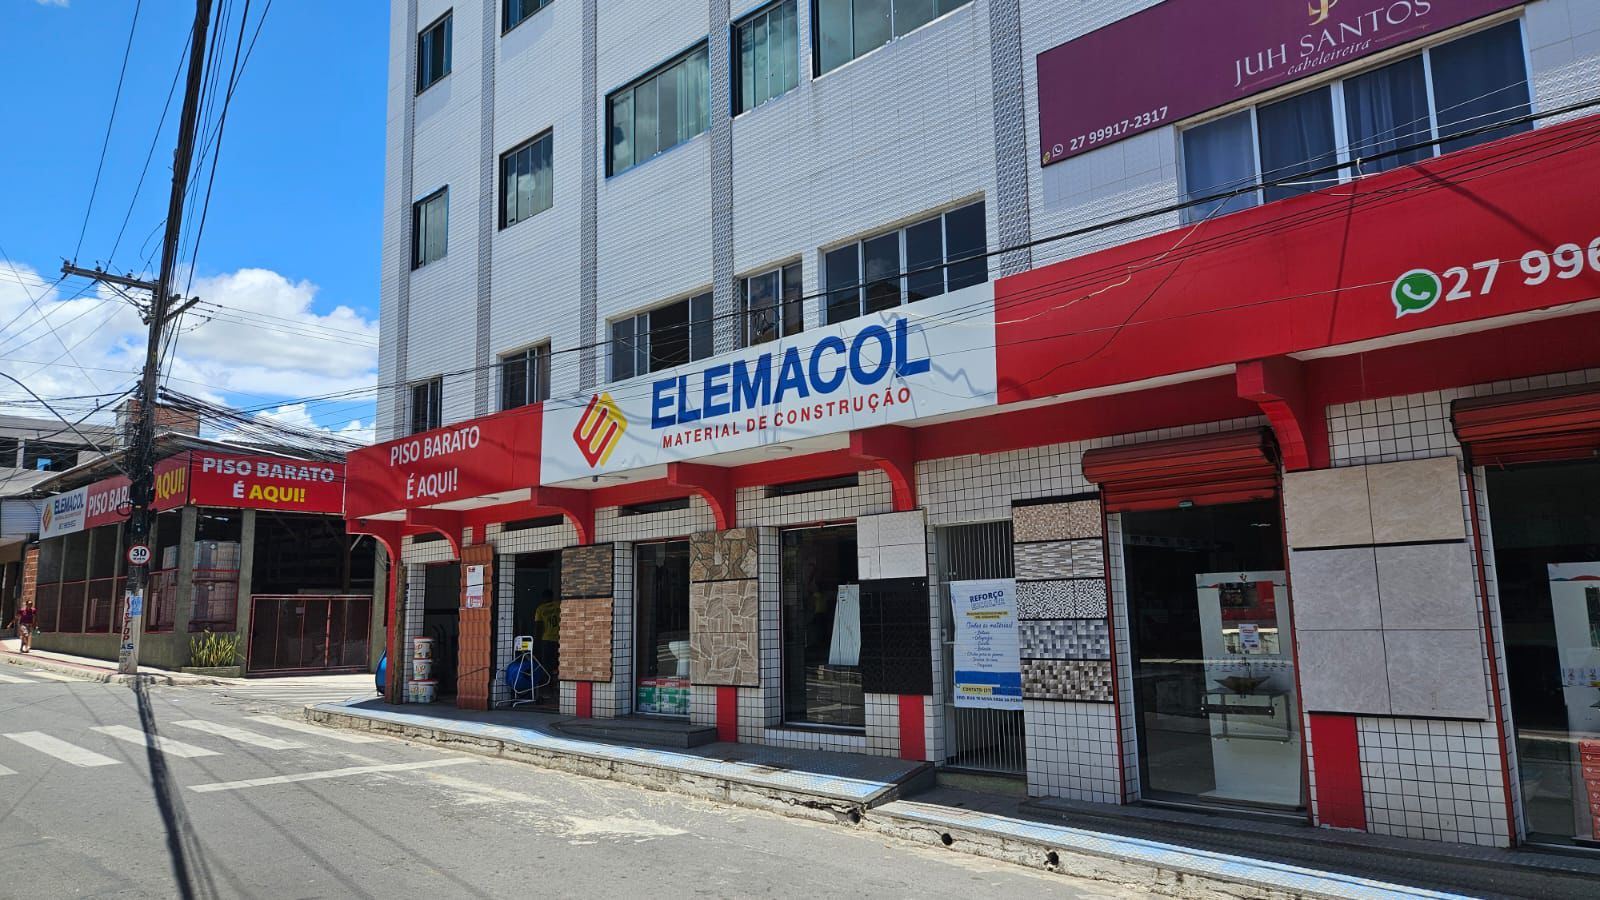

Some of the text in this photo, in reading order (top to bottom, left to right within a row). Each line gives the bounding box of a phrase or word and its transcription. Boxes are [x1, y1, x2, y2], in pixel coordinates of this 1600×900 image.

[1234, 43, 1287, 88] JUH
[1300, 0, 1432, 58] SANTOS
[1287, 38, 1372, 76] cabeleireira
[1070, 105, 1168, 151] 27 99917-2317
[1442, 258, 1500, 302] 27
[651, 318, 931, 430] ELEMACOL
[662, 386, 912, 449] MATERIAL DE CONSTRUÇÃO
[390, 425, 480, 467] PISO BARATO
[155, 467, 185, 500] AQUI!
[202, 457, 335, 483] PISO BARATO
[406, 467, 458, 500] É AQUI!
[54, 492, 84, 515] ELEMACOL
[88, 491, 108, 518] PISO
[232, 480, 306, 503] É AQUI!
[132, 548, 147, 557] 30
[969, 590, 1004, 603] REFORÇO
